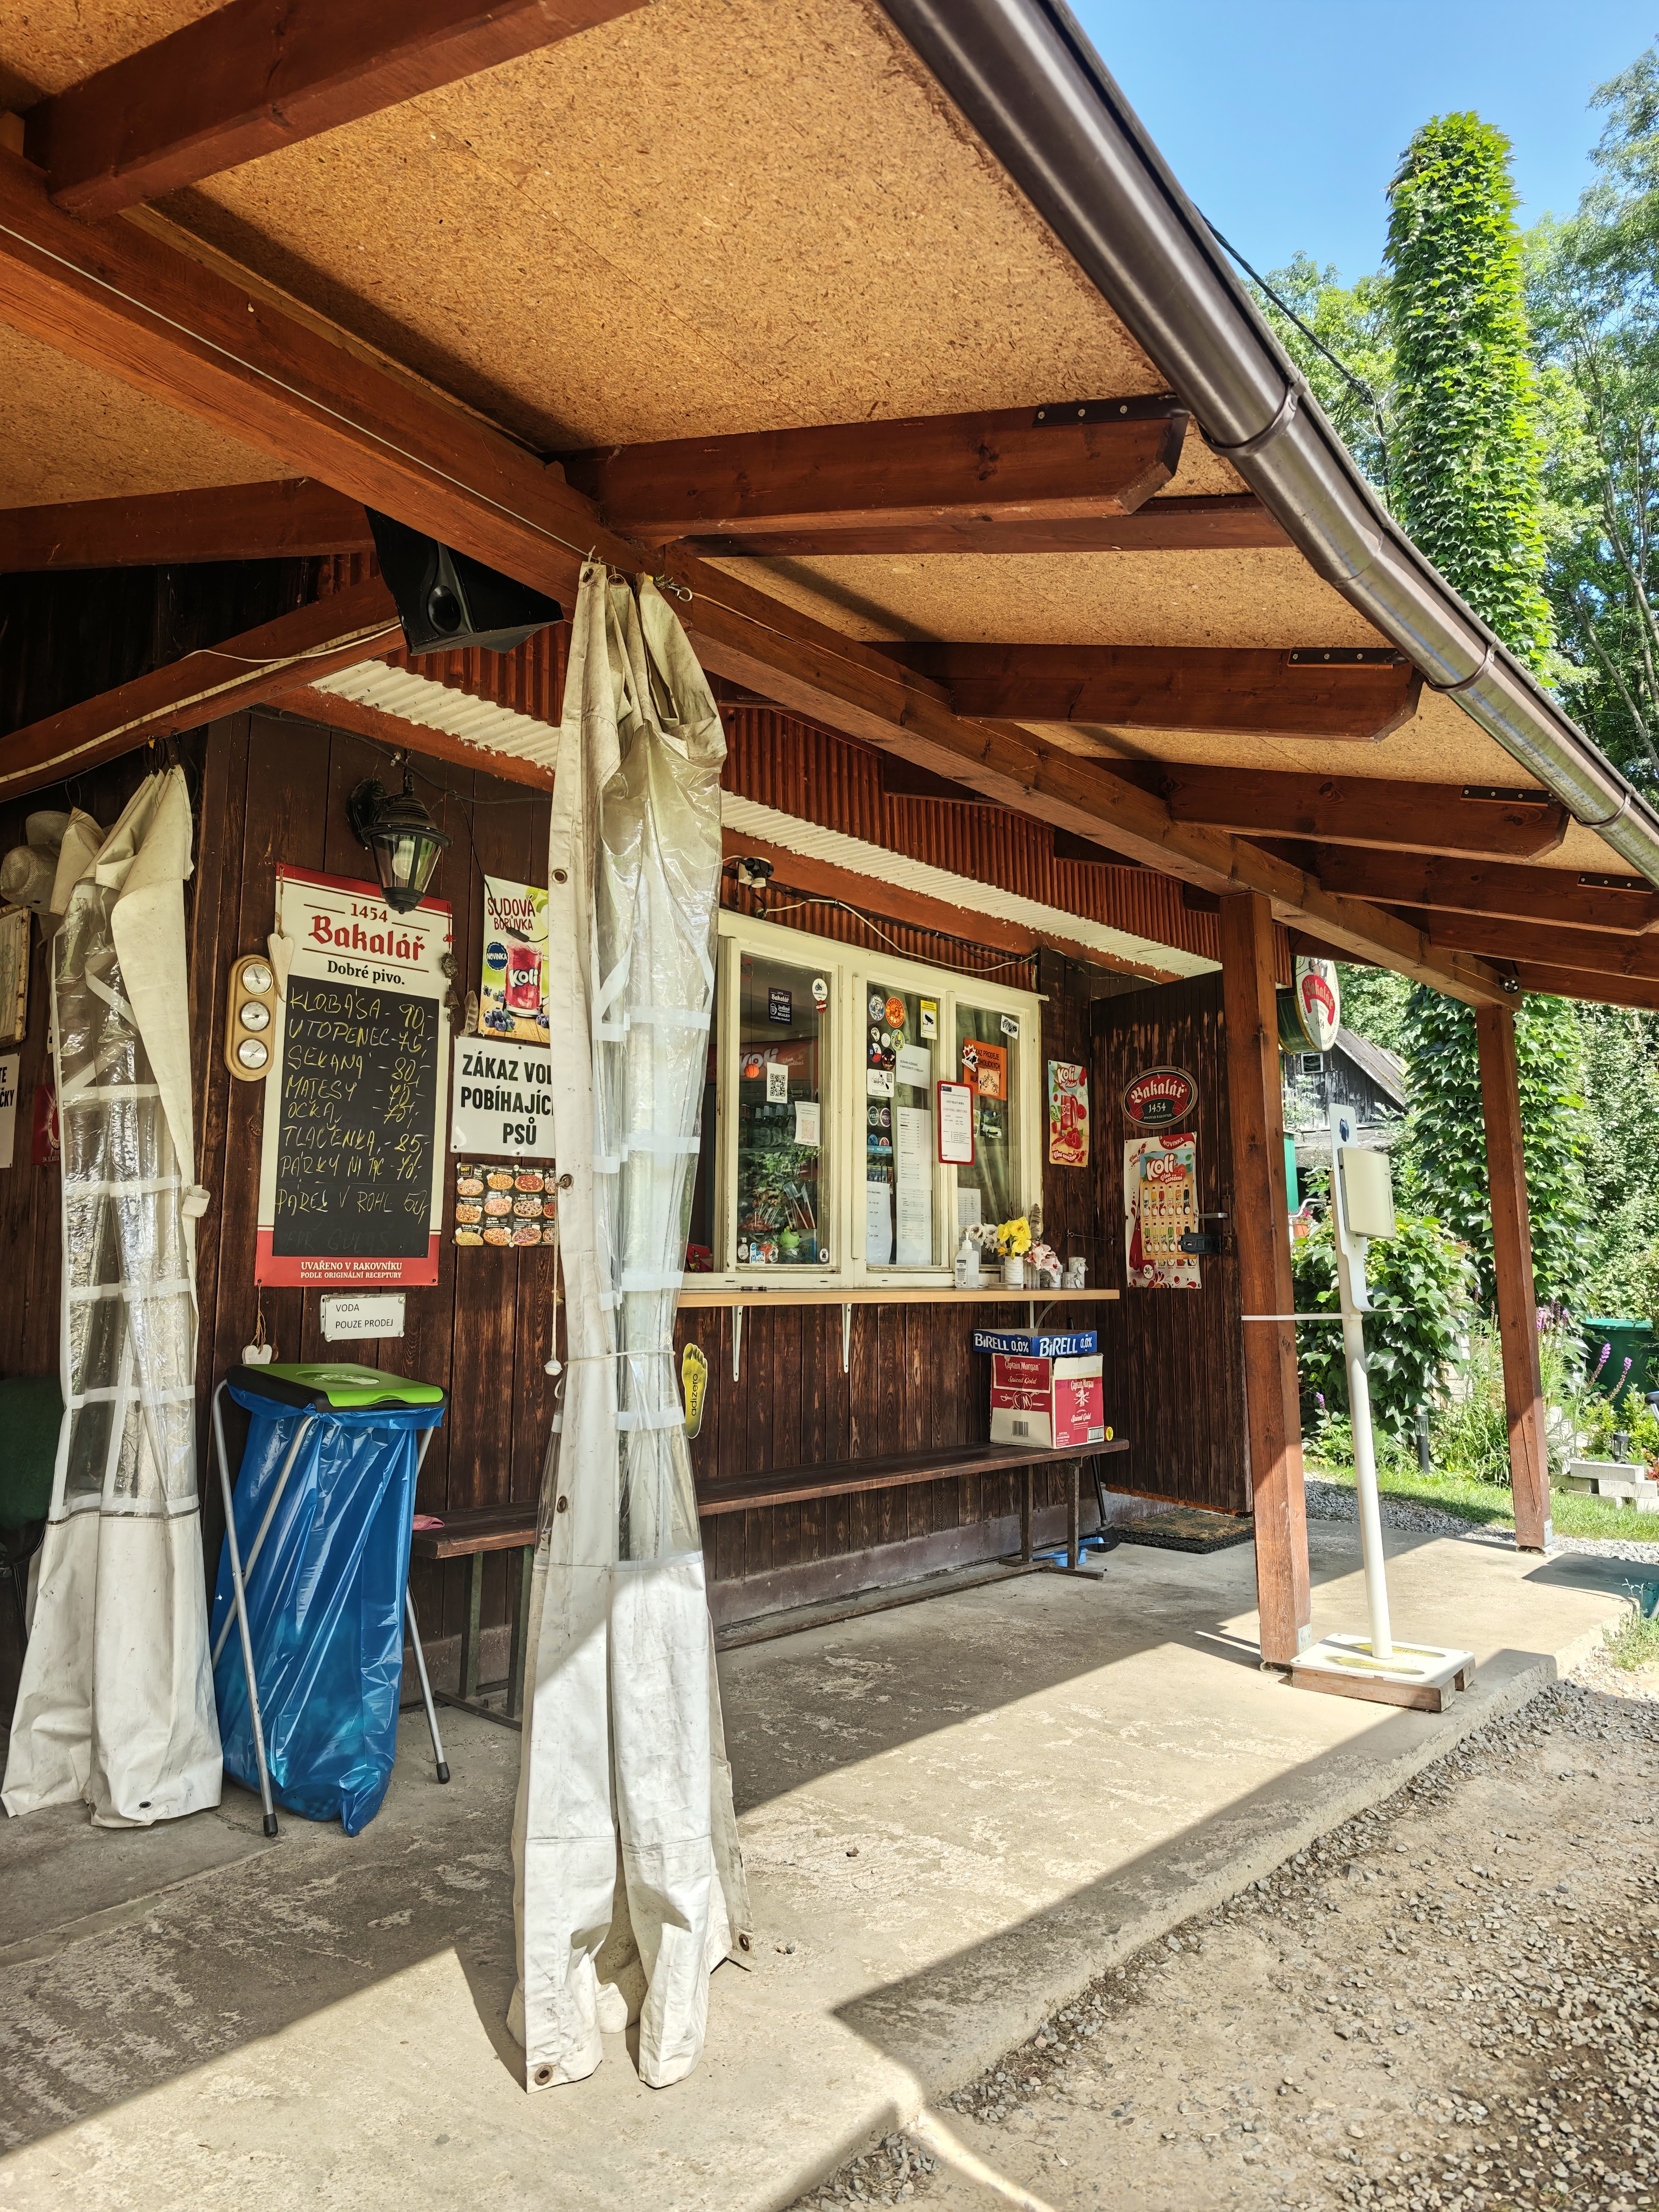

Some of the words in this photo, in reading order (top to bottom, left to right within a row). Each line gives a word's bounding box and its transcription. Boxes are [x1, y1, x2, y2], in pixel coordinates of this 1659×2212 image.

[487, 894, 536, 918] SUDOVÁ
[351, 903, 388, 923] 1454
[494, 915, 534, 931] BORŮVKA
[308, 915, 425, 961] Bakalář
[487, 952, 508, 961] NOVINKA
[327, 960, 369, 978] Dobré
[373, 969, 405, 984] pivo.
[771, 994, 790, 1003] Bakalář
[1304, 979, 1334, 1009] Bakalář
[290, 987, 380, 1020] KLOBÁSA
[983, 1050, 1000, 1061] PRODEJE
[462, 1051, 518, 1082] ZÁKAZ
[524, 1062, 552, 1085] VOL
[978, 1058, 1001, 1070] OHOLICKÝCH
[1131, 1078, 1186, 1104] Bakalář
[461, 1085, 554, 1116] POBÍHAJÍC
[1148, 1102, 1166, 1114] 1454
[503, 1116, 537, 1145] PSŮ
[1162, 1137, 1184, 1147] NOVINKA
[301, 1260, 343, 1270] UVAŘENO
[345, 1262, 352, 1270] V
[353, 1260, 402, 1270] RAKOVNÍKU
[335, 1304, 360, 1312] VODA
[335, 1320, 362, 1329] POUZE
[365, 1318, 393, 1328] PRODEJ
[1011, 1340, 1029, 1353] 0,0%
[1080, 1336, 1092, 1349] 0,0%
[1004, 1360, 1021, 1370] Captain
[1008, 1375, 1024, 1384] Spiced
[1024, 1377, 1037, 1385] Gold
[690, 1373, 698, 1416] adizero
[1070, 1414, 1083, 1422] Spiced
[1083, 1412, 1092, 1421] Gold
